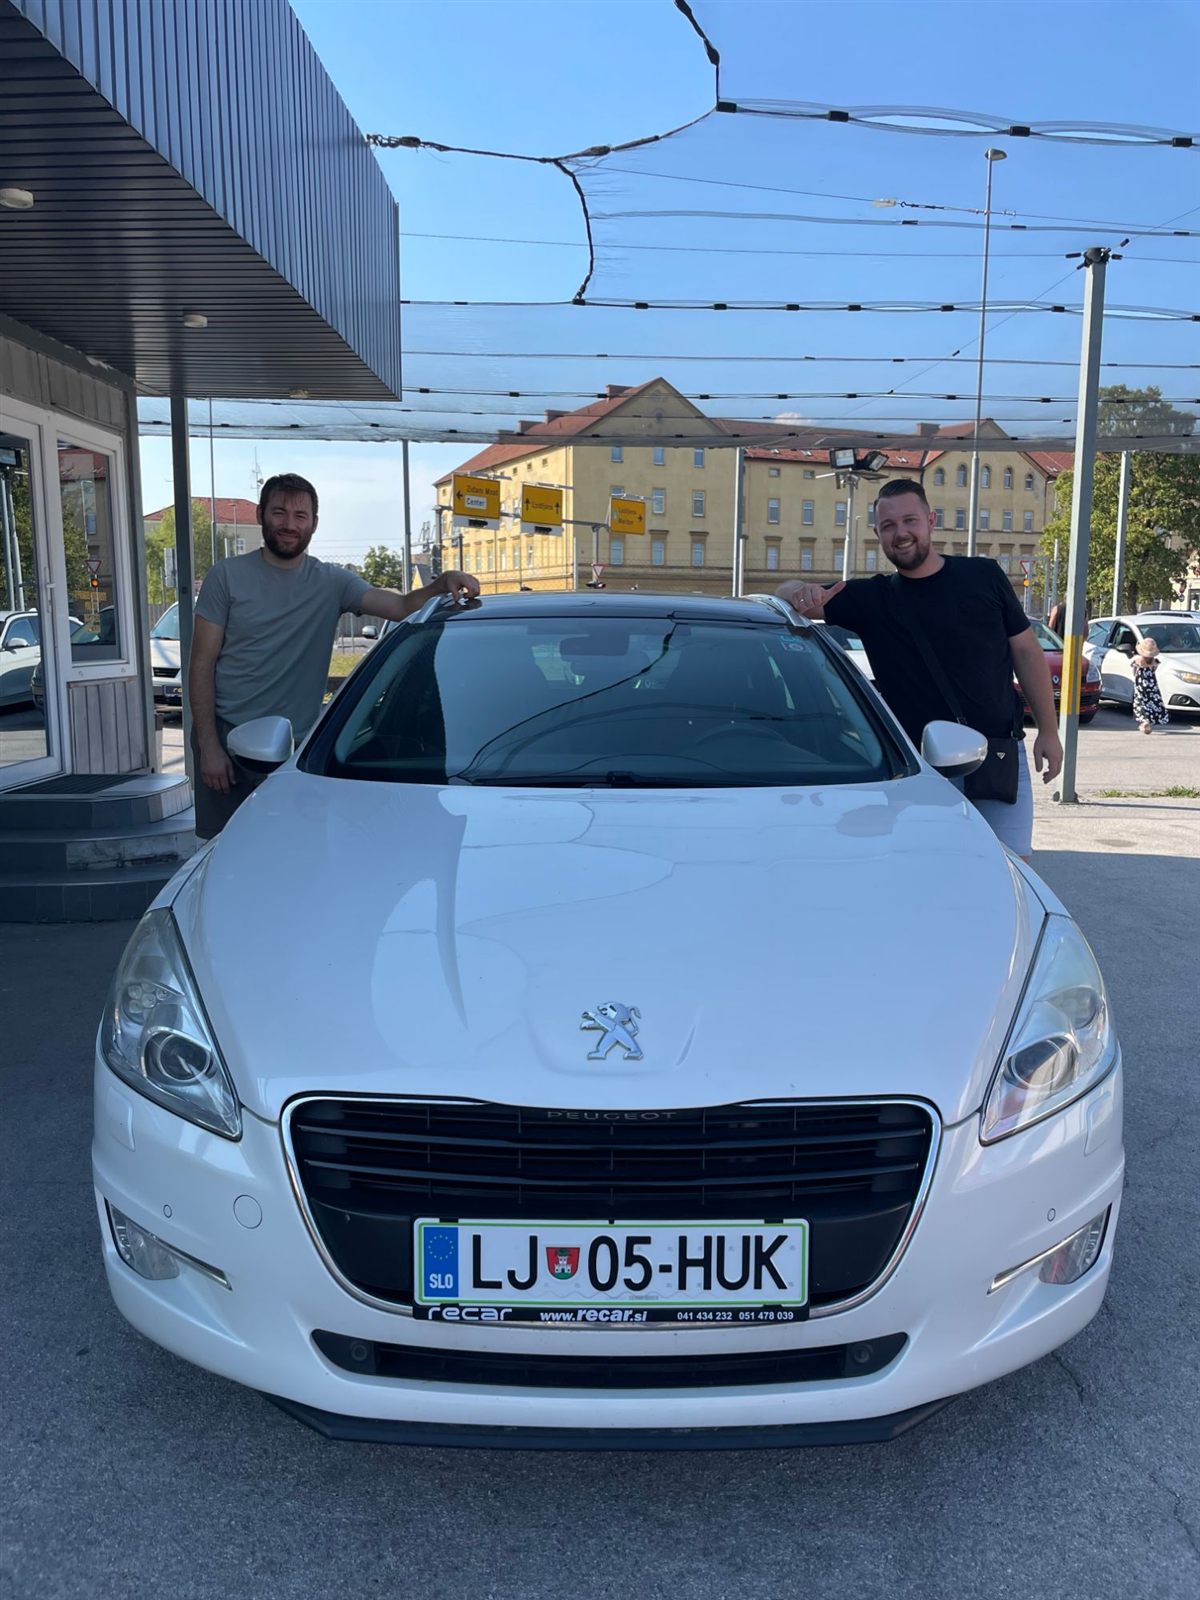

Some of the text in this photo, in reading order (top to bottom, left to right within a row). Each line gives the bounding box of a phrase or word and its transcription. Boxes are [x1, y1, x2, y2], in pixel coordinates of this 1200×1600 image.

[547, 1111, 677, 1120] PEUGEOT
[472, 1234, 789, 1291] LJ 05-HUK
[429, 1273, 453, 1289] SLO
[428, 1307, 513, 1321] recar
[540, 1308, 647, 1322] www.recar.si
[677, 1310, 794, 1320] 041 434 232 051 478 039
